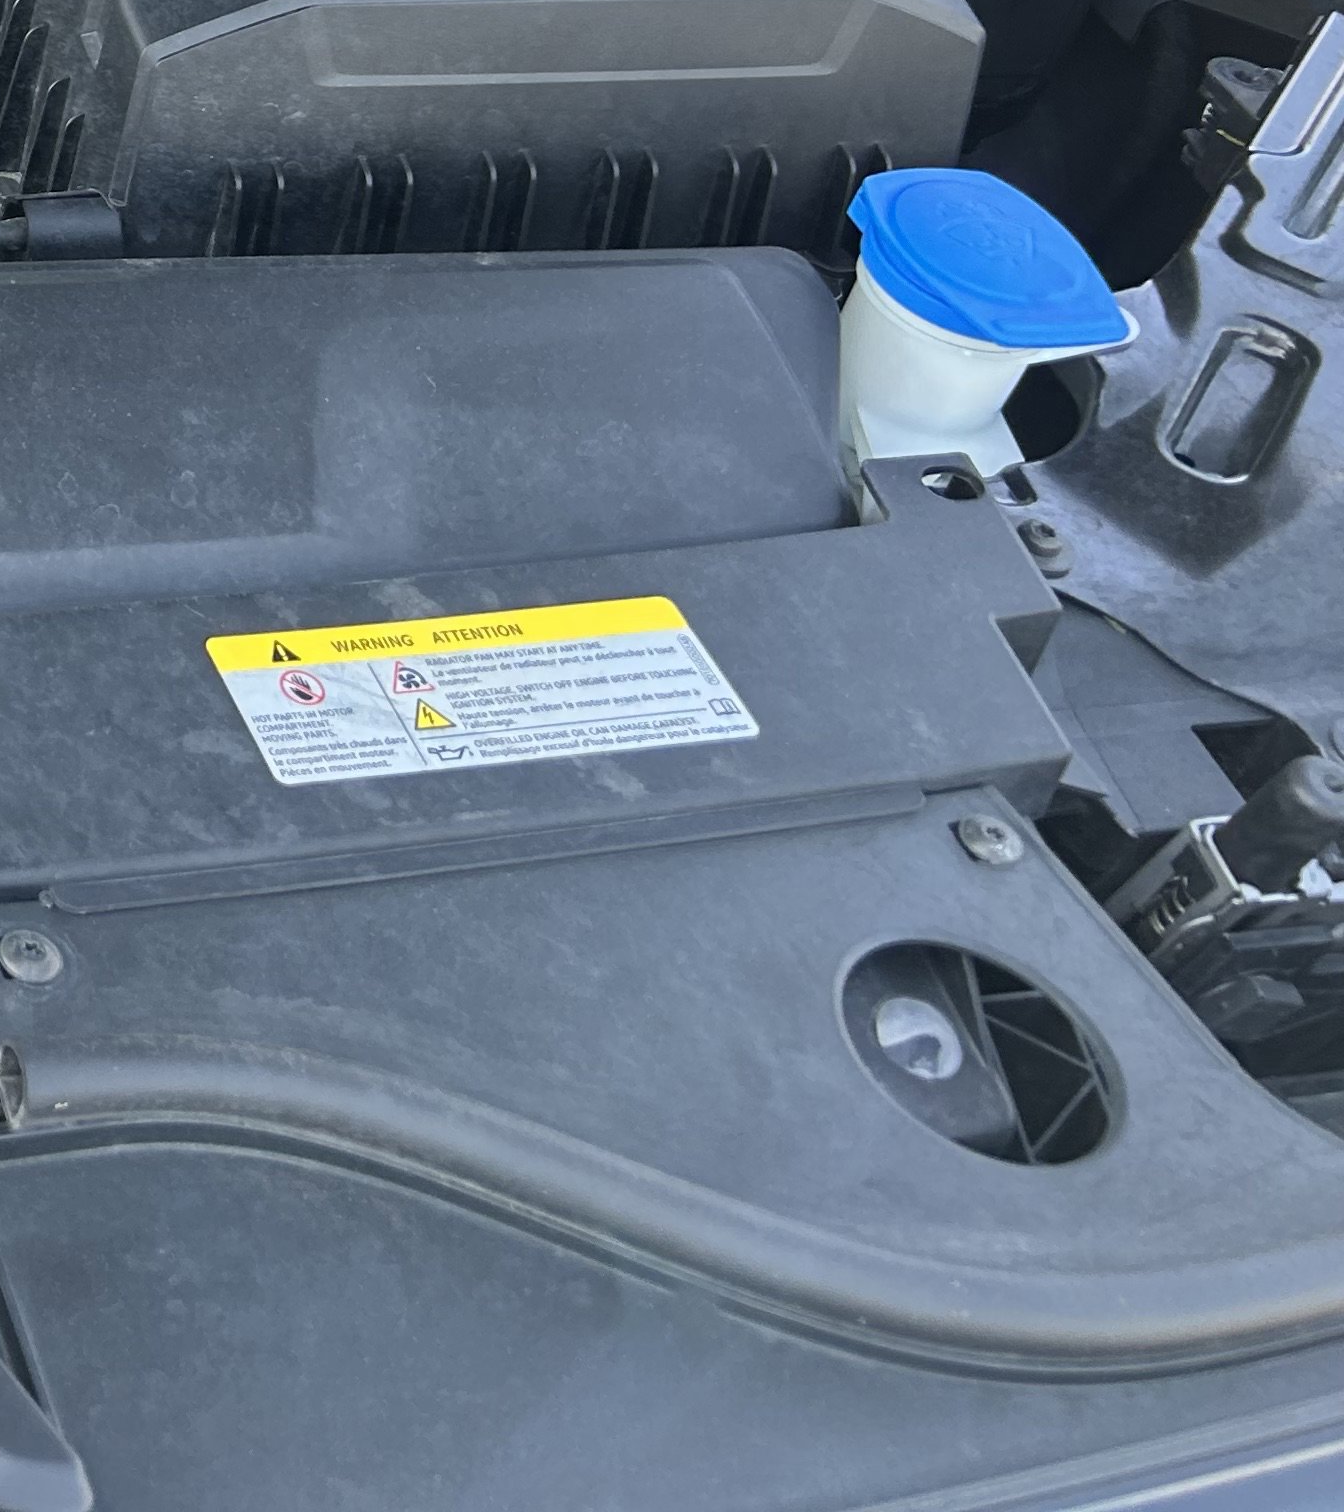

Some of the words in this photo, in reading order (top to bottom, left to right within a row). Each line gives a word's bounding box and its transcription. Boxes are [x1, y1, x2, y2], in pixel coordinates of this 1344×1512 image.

[331, 635, 413, 652] WARNING
[433, 624, 522, 643] ATTENTION
[425, 654, 473, 665] RADIATOR
[494, 651, 514, 659] MAY
[516, 647, 544, 656] START
[445, 691, 470, 700] HIGH
[516, 683, 553, 692] SWITCH
[554, 680, 572, 688] OFF
[574, 676, 609, 686] ENGINE
[450, 698, 494, 708] IGNITION
[251, 714, 271, 723] HOT
[273, 712, 304, 721] PARTS
[318, 707, 354, 717] MOTOR
[262, 732, 302, 742] MOVING
[474, 734, 532, 747] OVERFILLED
[533, 730, 570, 741] ENGINE
[571, 729, 588, 737] OIL
[588, 726, 609, 735] CAN
[610, 722, 652, 732] DAMAGE
